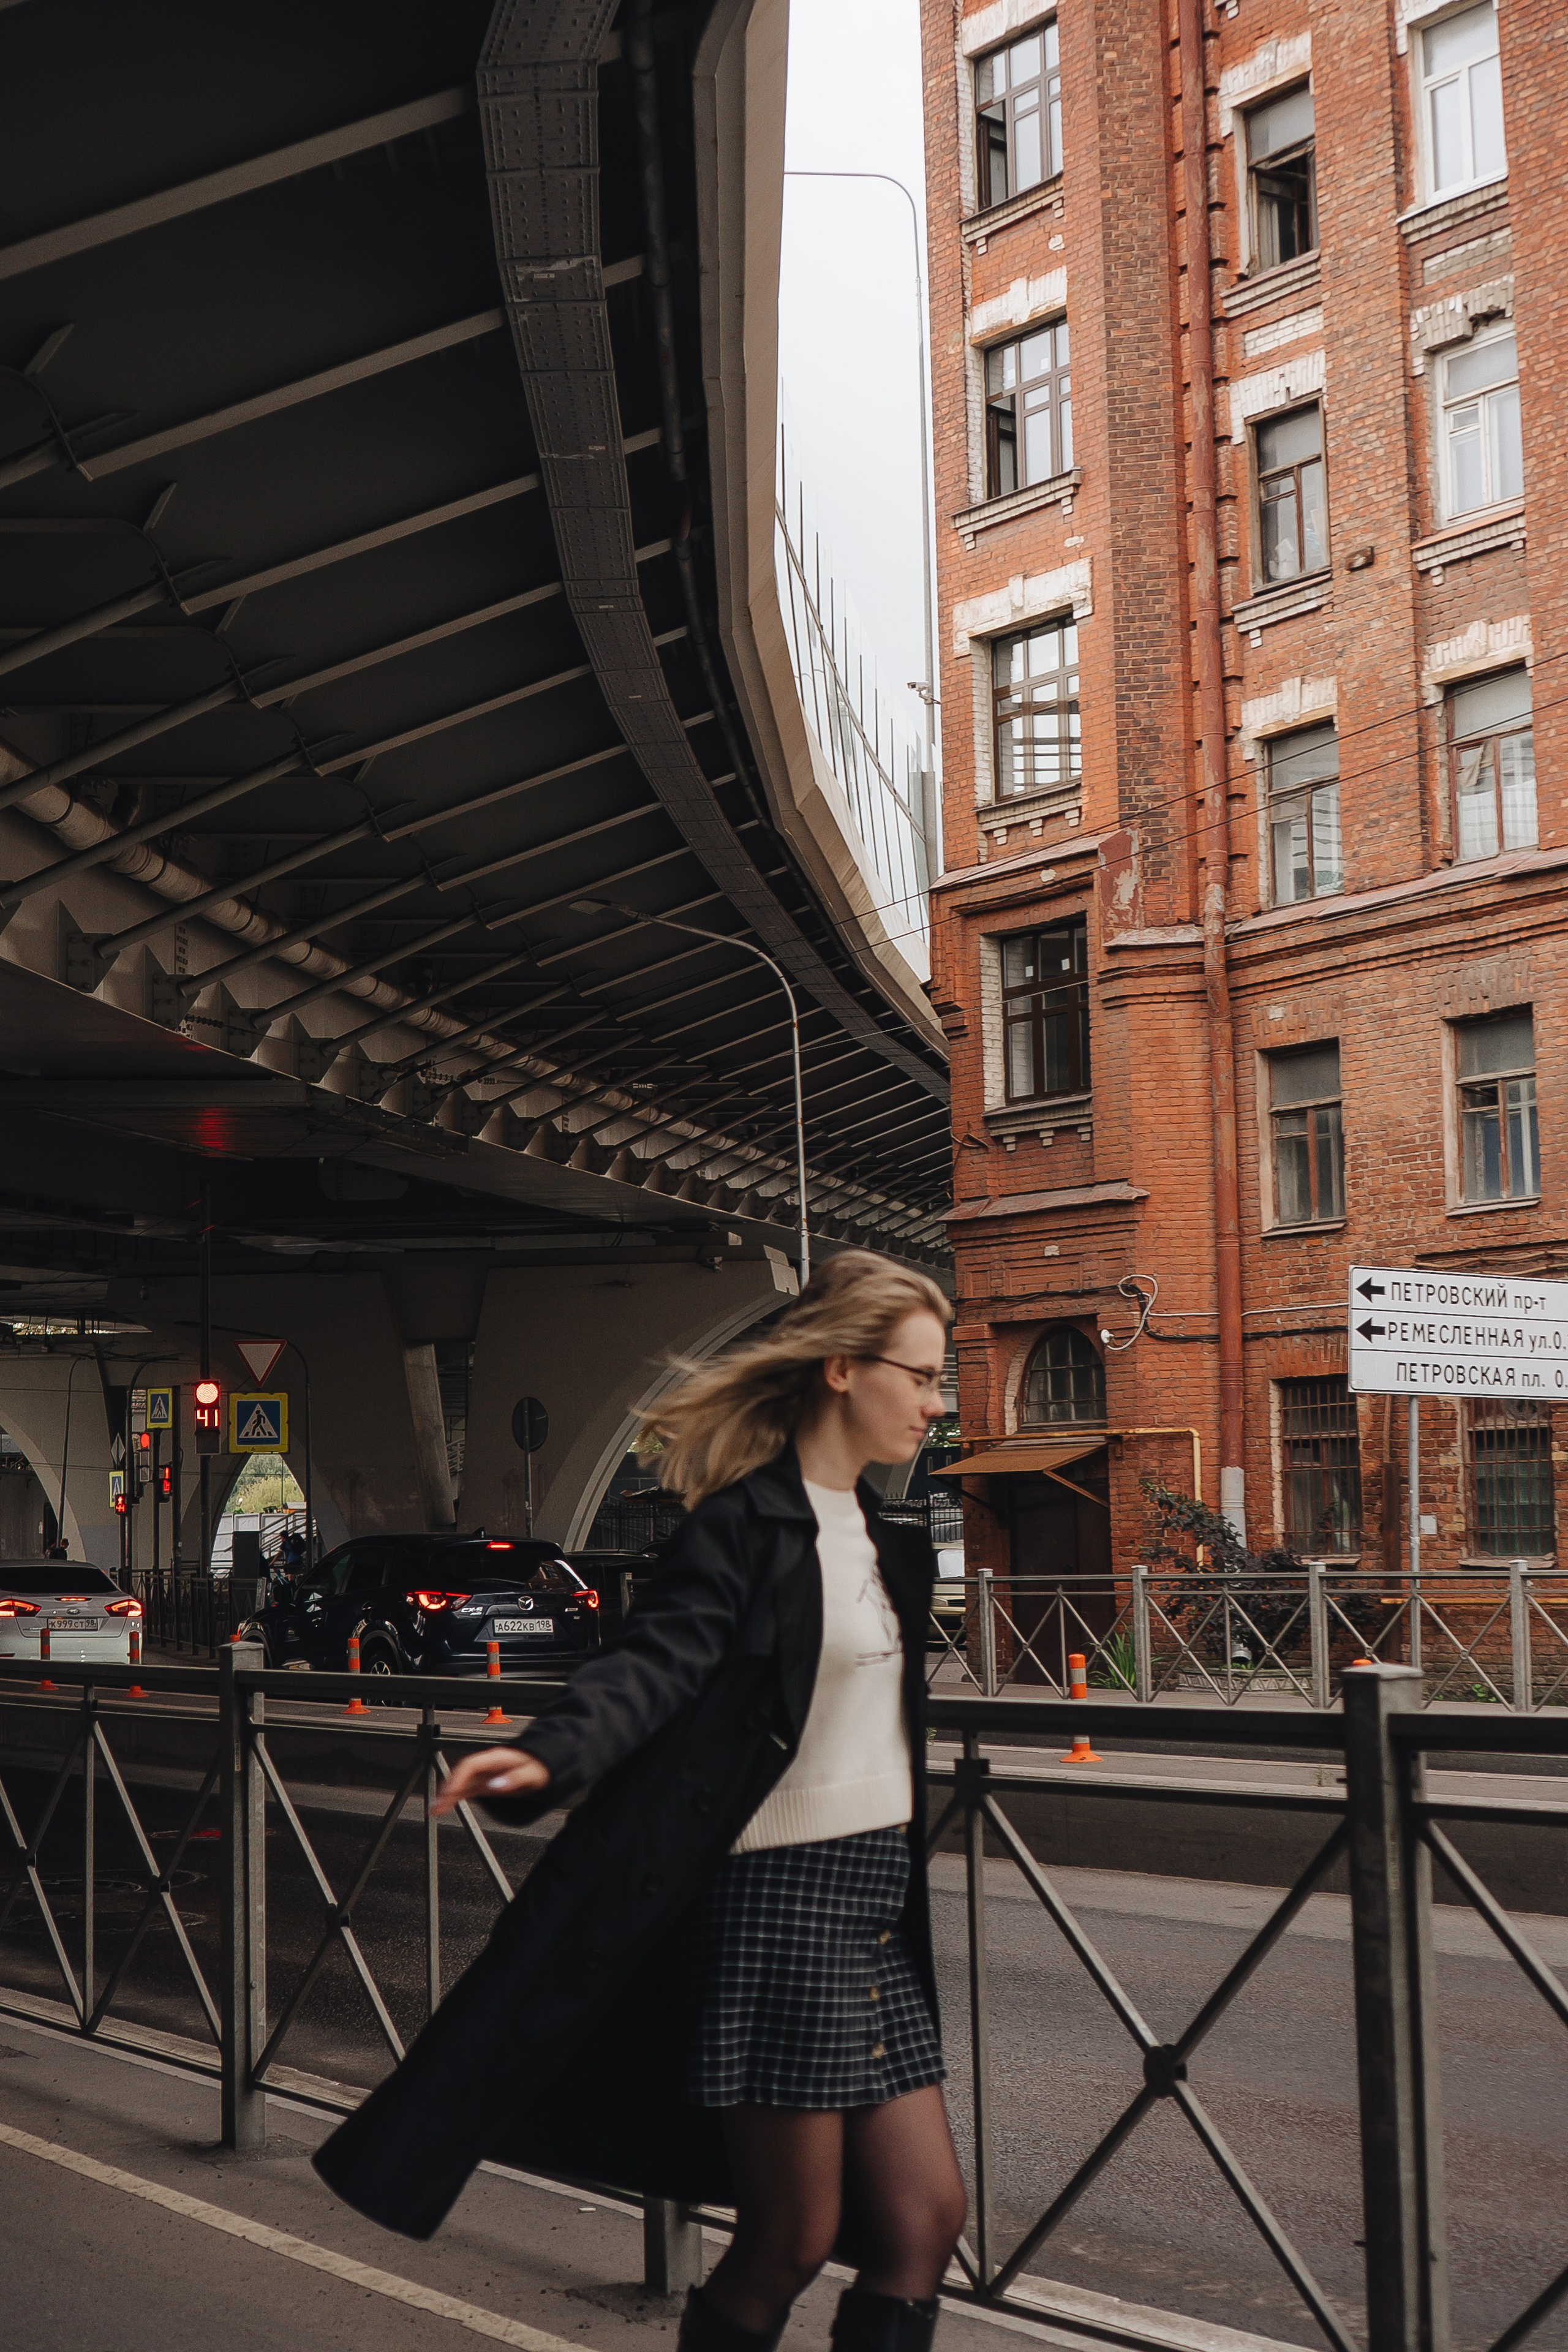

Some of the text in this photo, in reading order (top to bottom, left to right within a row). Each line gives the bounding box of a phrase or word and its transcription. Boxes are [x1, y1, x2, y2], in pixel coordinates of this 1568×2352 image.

[1391, 1281, 1547, 1314] ПЕТРОВСКИЙ пр-т
[1387, 1321, 1524, 1348] РЕМЕСЛЕННАЯ
[1553, 1331, 1568, 1350] 0.
[1396, 1362, 1517, 1387] ПЕТРОВСКАЯ
[1521, 1373, 1545, 1387] пл.
[197, 1409, 219, 1427] 41
